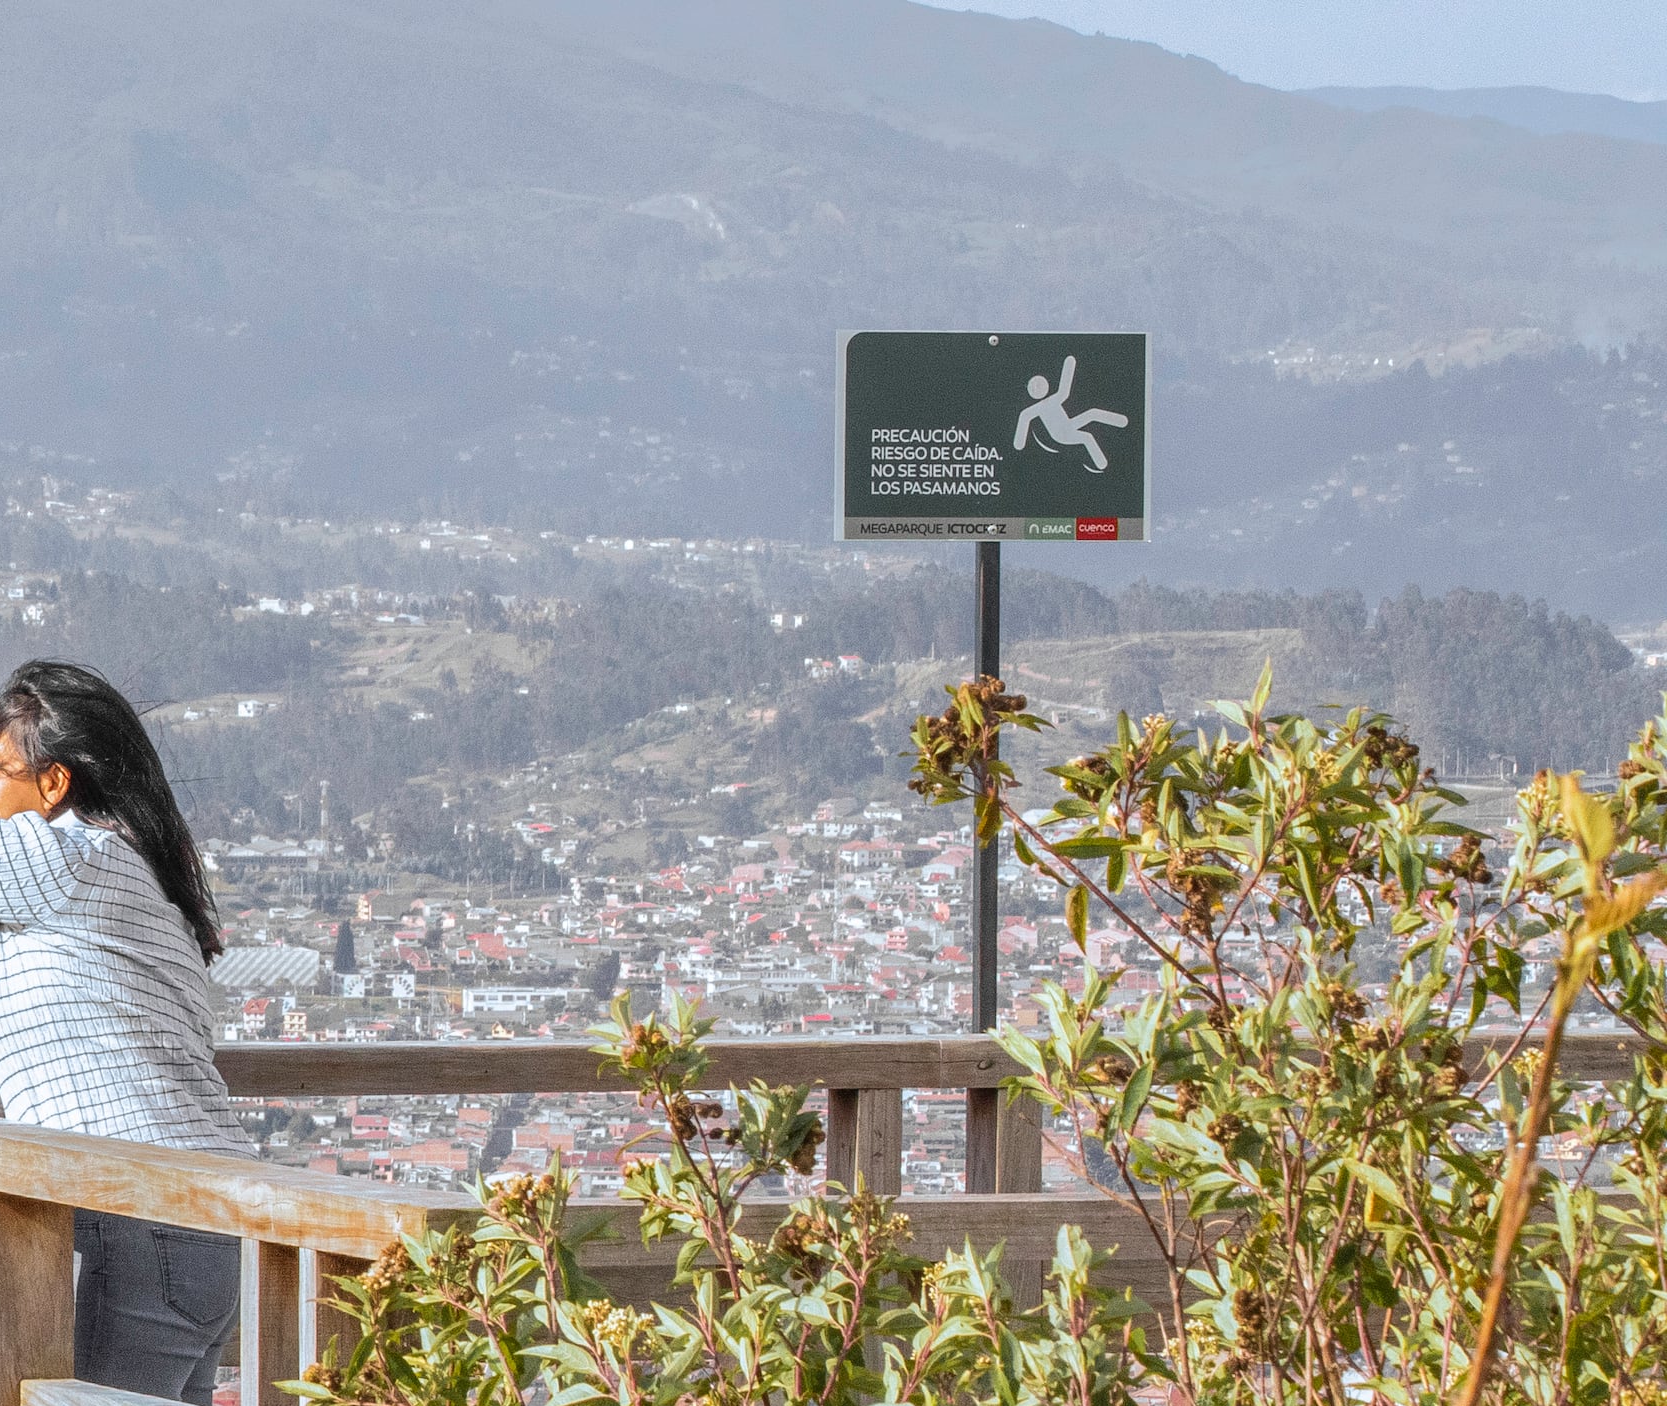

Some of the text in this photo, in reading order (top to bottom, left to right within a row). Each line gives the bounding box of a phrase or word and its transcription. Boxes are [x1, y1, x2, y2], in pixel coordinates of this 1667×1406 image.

[871, 426, 969, 443] PRECAUCIÓN
[871, 443, 1003, 460] RIESGO DE CAÍDA.
[871, 464, 994, 477] NO SE SIENTE EN
[871, 481, 1000, 495] LOS PASAMANOS
[860, 523, 1007, 536] MEGAPARQUE ICTOCRZ
[1042, 524, 1072, 534] EMAC
